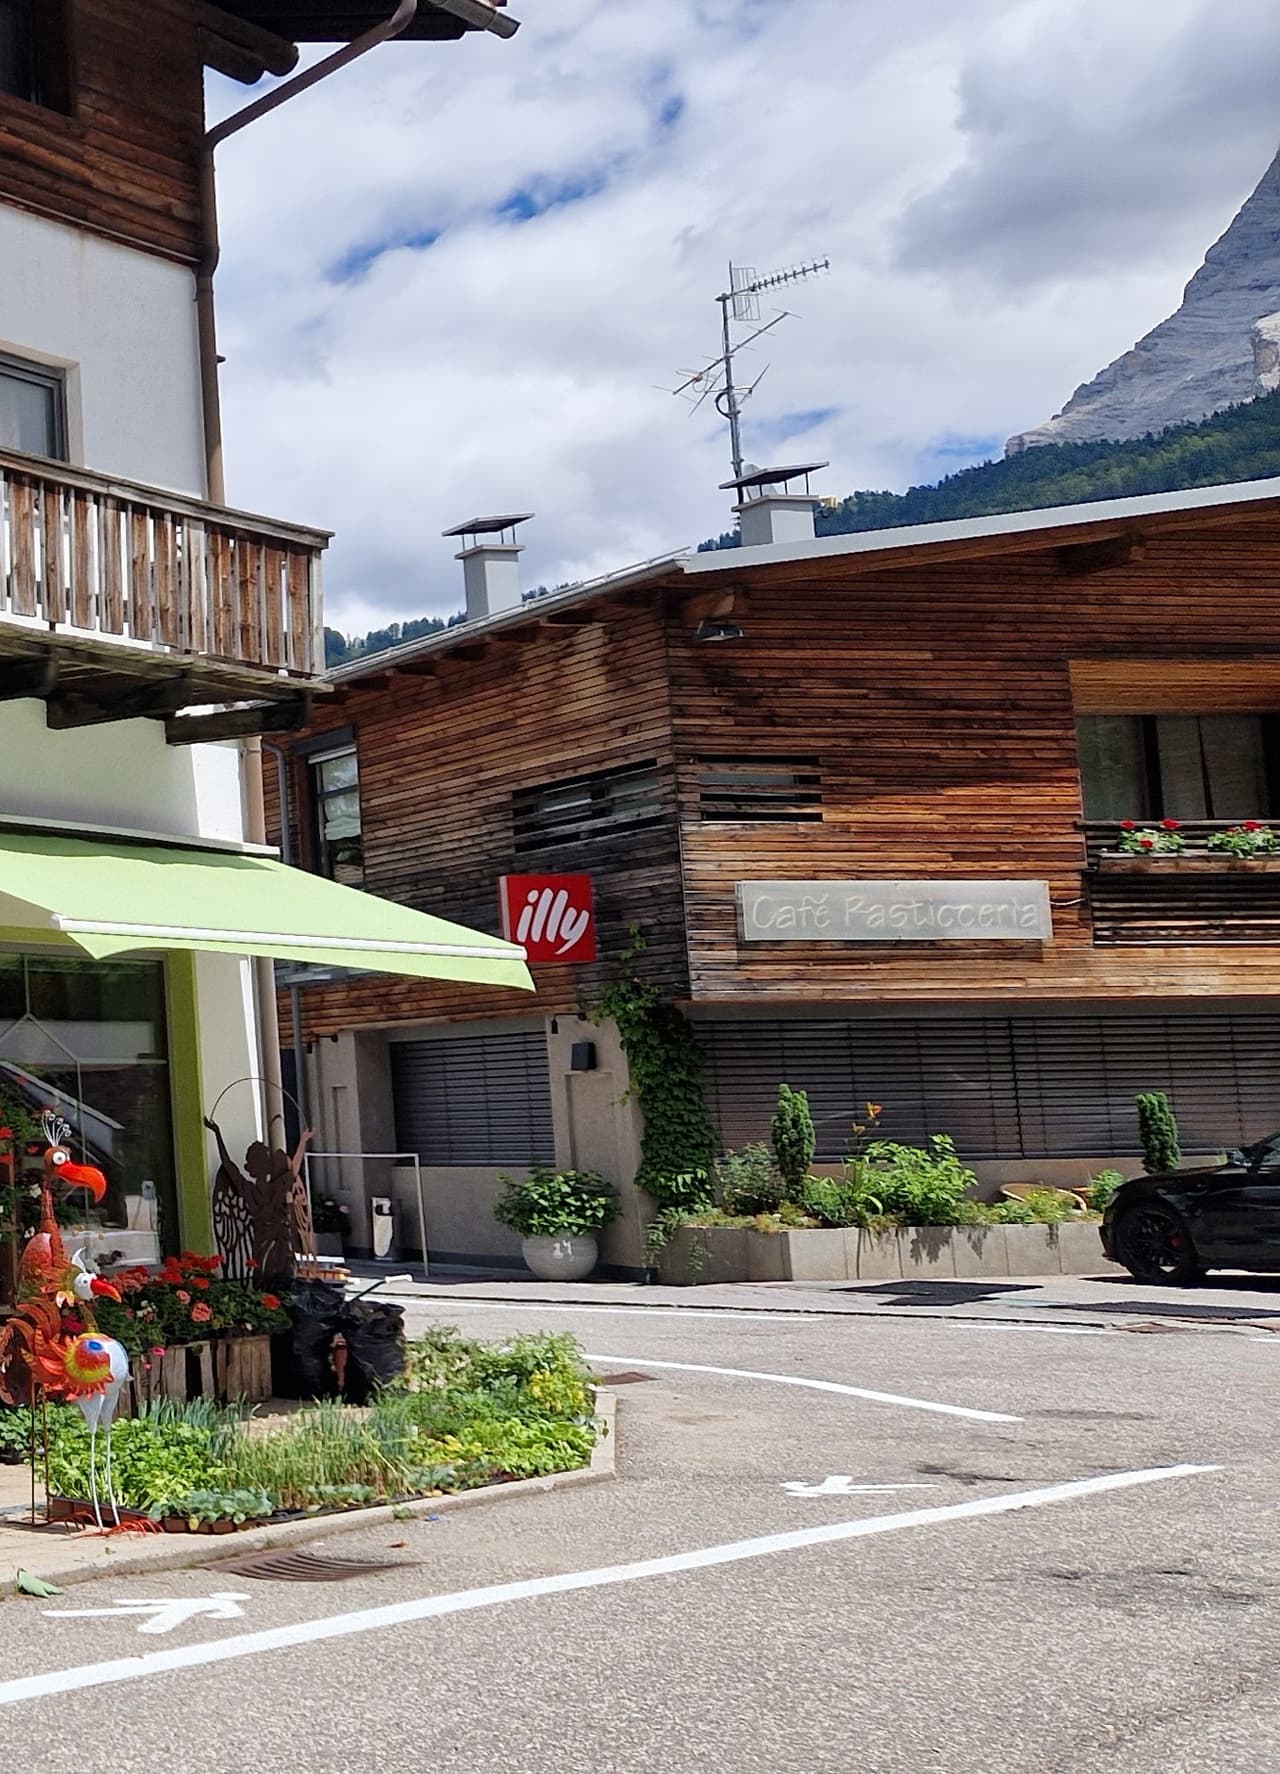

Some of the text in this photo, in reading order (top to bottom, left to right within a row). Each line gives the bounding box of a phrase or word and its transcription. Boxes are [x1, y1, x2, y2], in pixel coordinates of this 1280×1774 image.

[516, 887, 590, 955] illy
[752, 893, 1038, 929] Café Pasticceria
